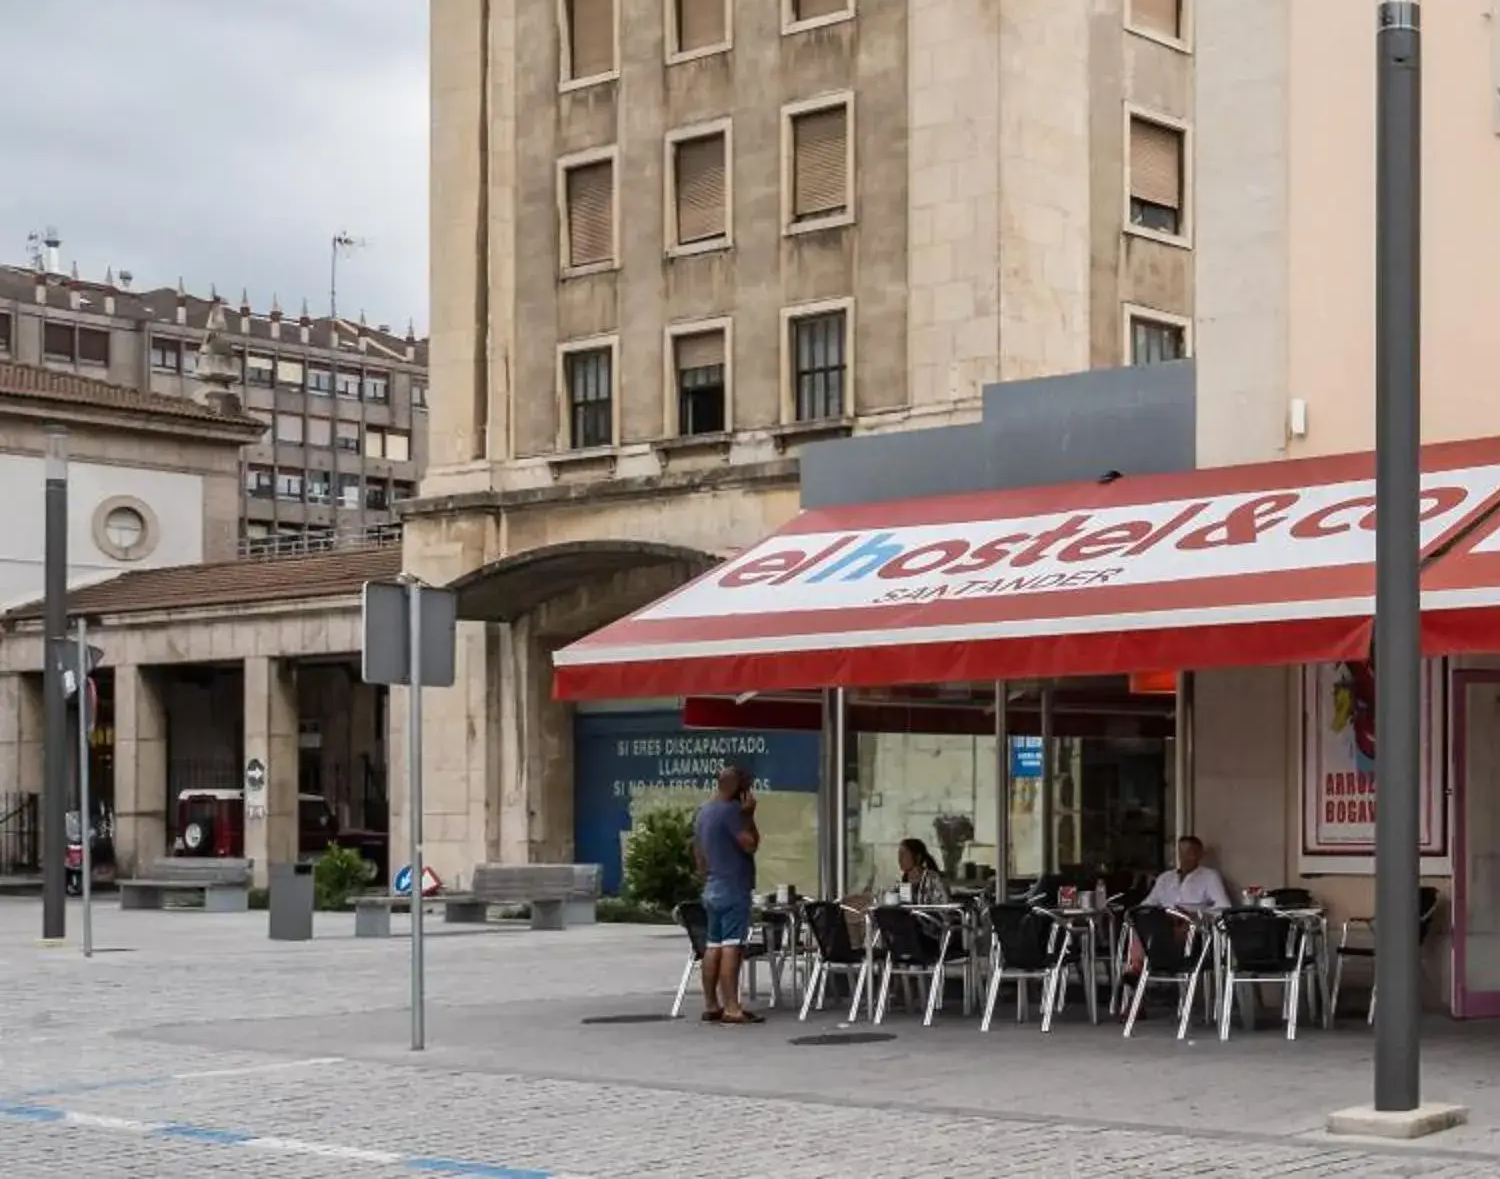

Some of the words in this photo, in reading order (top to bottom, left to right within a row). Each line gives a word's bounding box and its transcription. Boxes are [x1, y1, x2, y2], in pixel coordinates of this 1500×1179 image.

[873, 568, 1124, 604] SANTANDER
[617, 740, 629, 756] SI
[633, 739, 661, 755] ERES
[613, 780, 625, 796] SI
[1326, 801, 1377, 823] BOGAV
